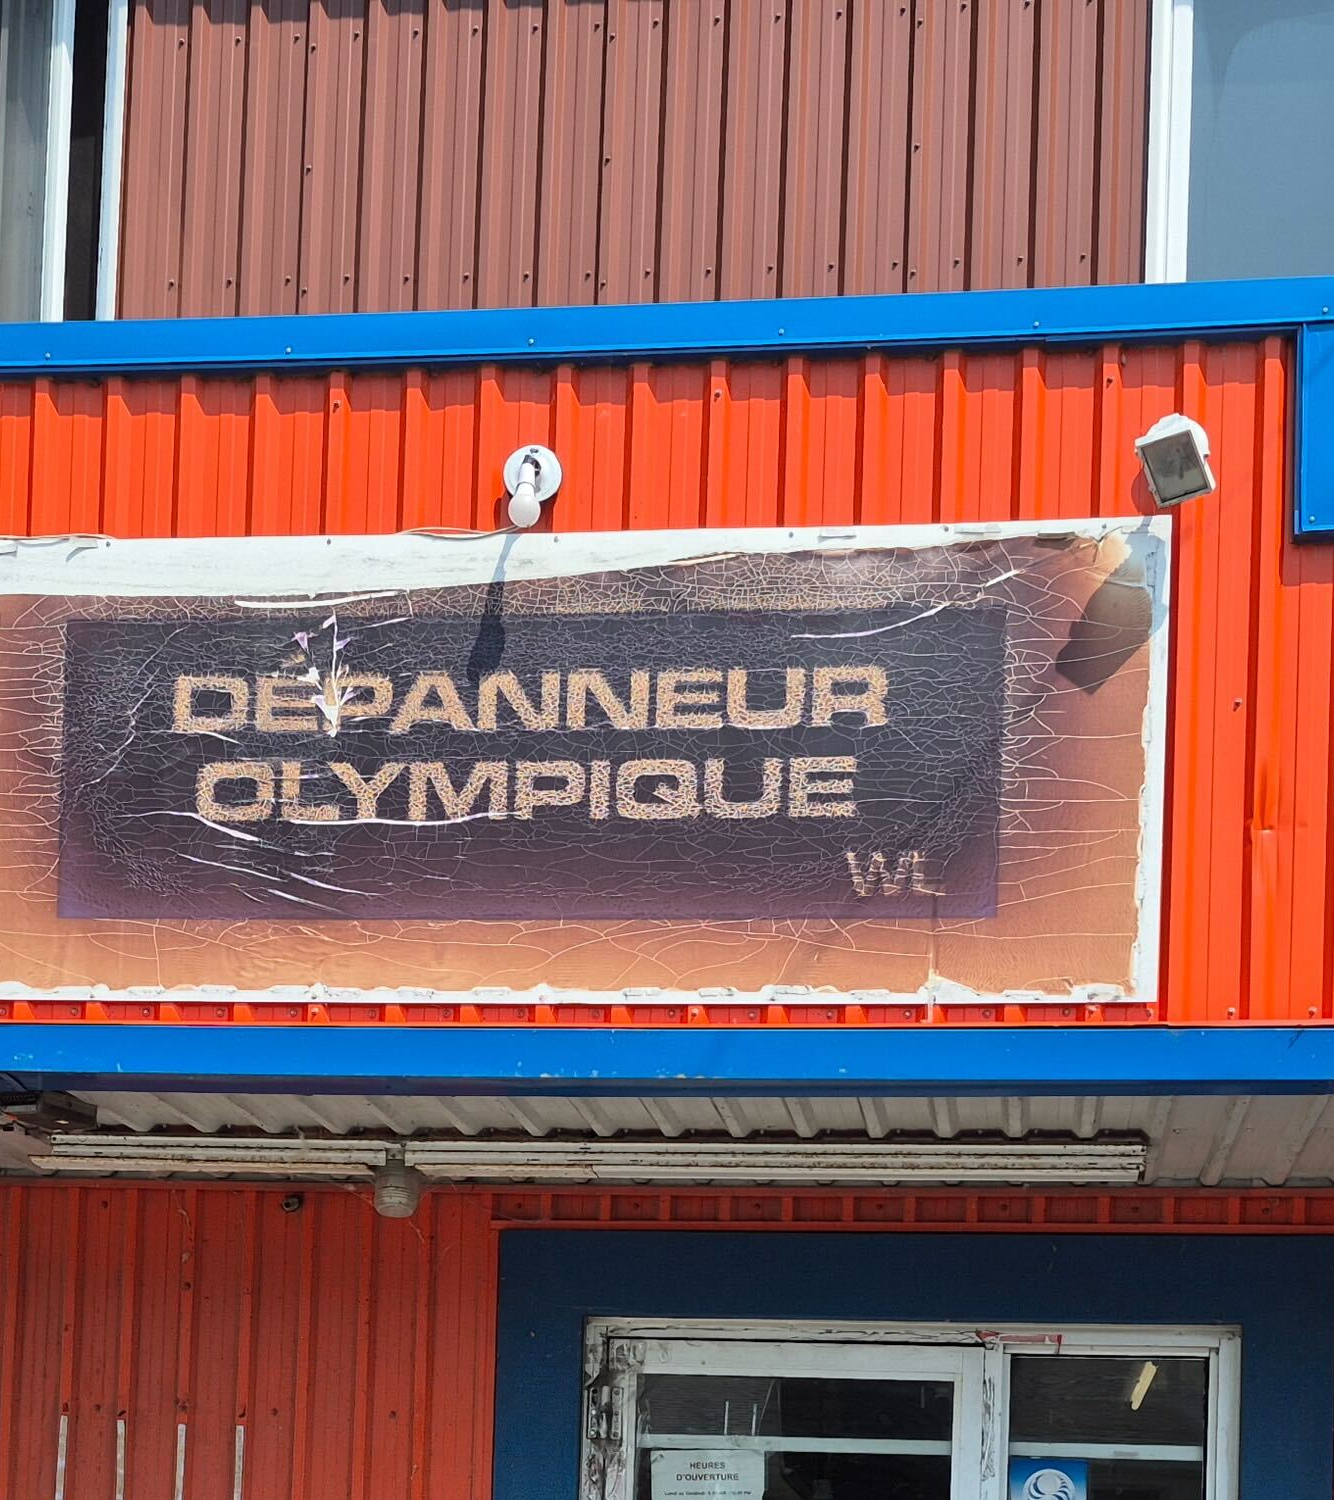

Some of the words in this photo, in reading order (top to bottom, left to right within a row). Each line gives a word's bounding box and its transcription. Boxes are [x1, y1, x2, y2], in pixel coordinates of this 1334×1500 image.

[171, 654, 889, 735] DÉPANNEUR
[194, 756, 859, 822] OLYMPIQUE
[676, 1472, 740, 1482] D'OUVERTURE
[690, 1461, 726, 1470] HEURES
